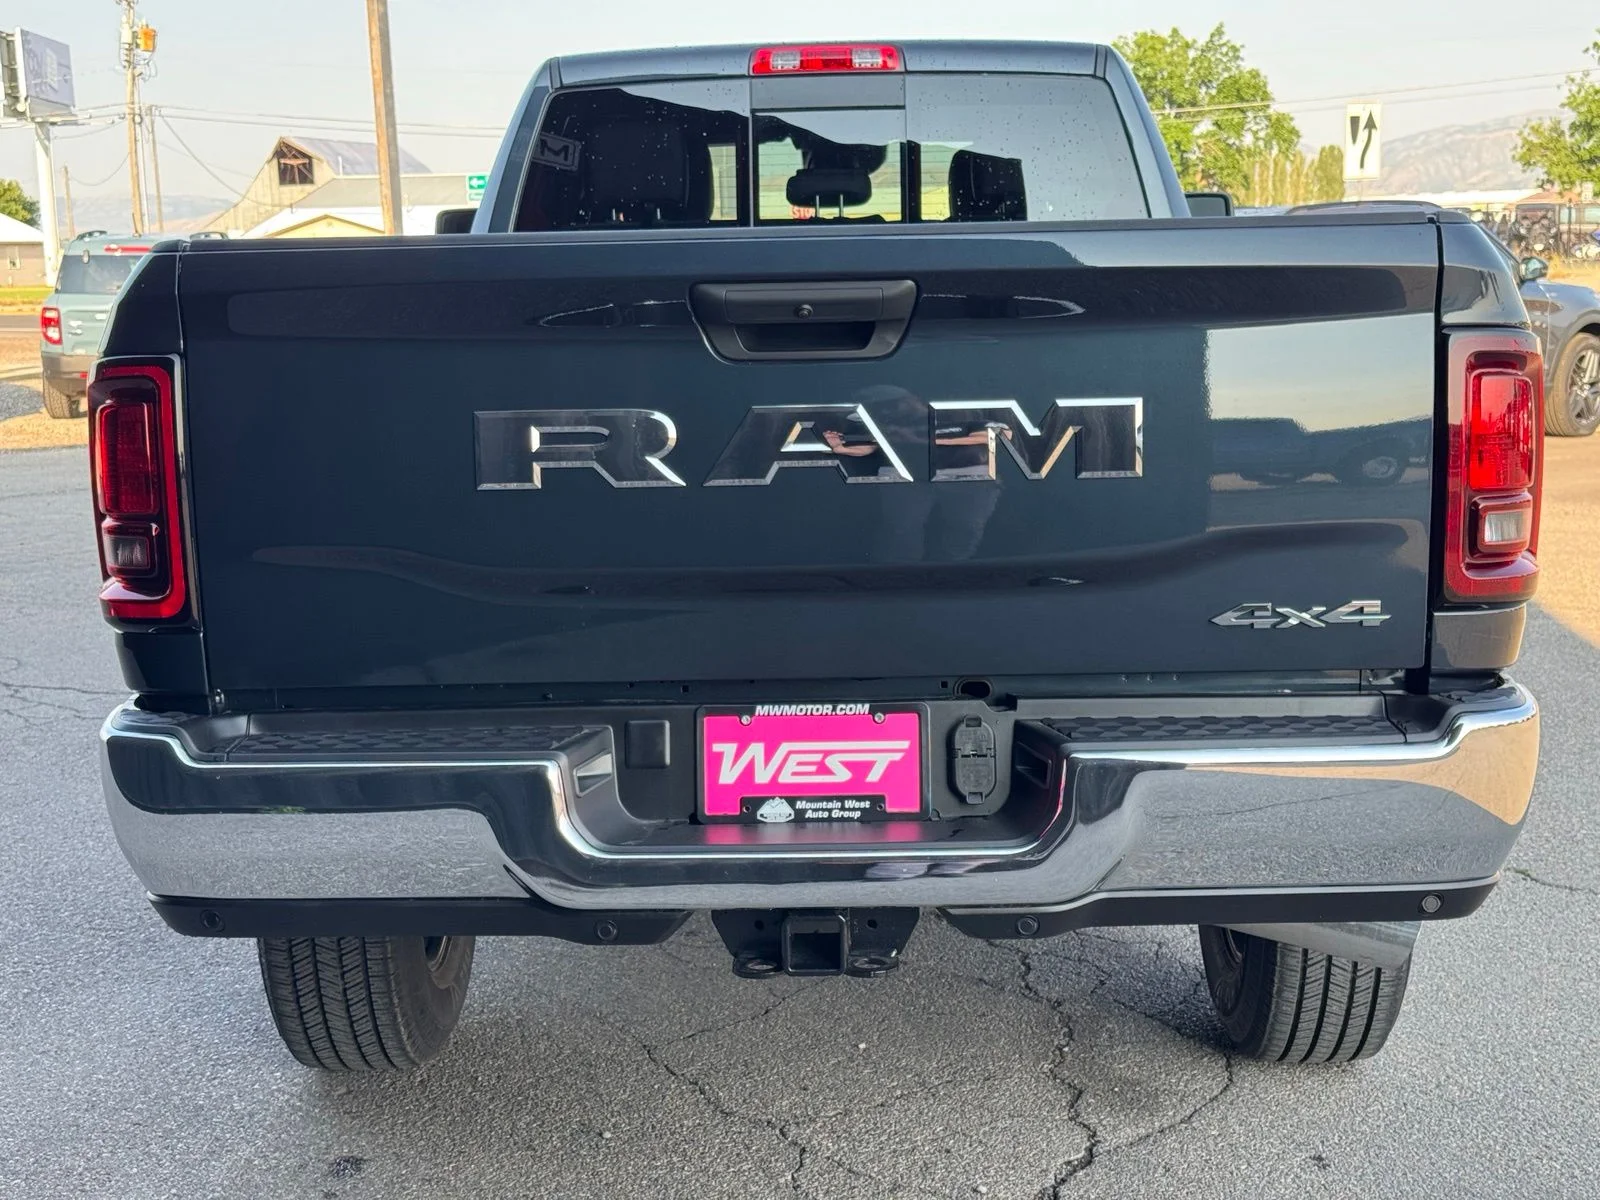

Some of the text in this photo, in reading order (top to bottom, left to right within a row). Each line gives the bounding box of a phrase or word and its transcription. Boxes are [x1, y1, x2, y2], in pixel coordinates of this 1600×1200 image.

[793, 206, 816, 219] STO
[473, 396, 1143, 490] RAM
[755, 704, 870, 716] MWMOTOR.COM
[712, 740, 910, 785] WEST
[796, 800, 870, 809] Mountain West
[805, 809, 861, 819] Auto Group
